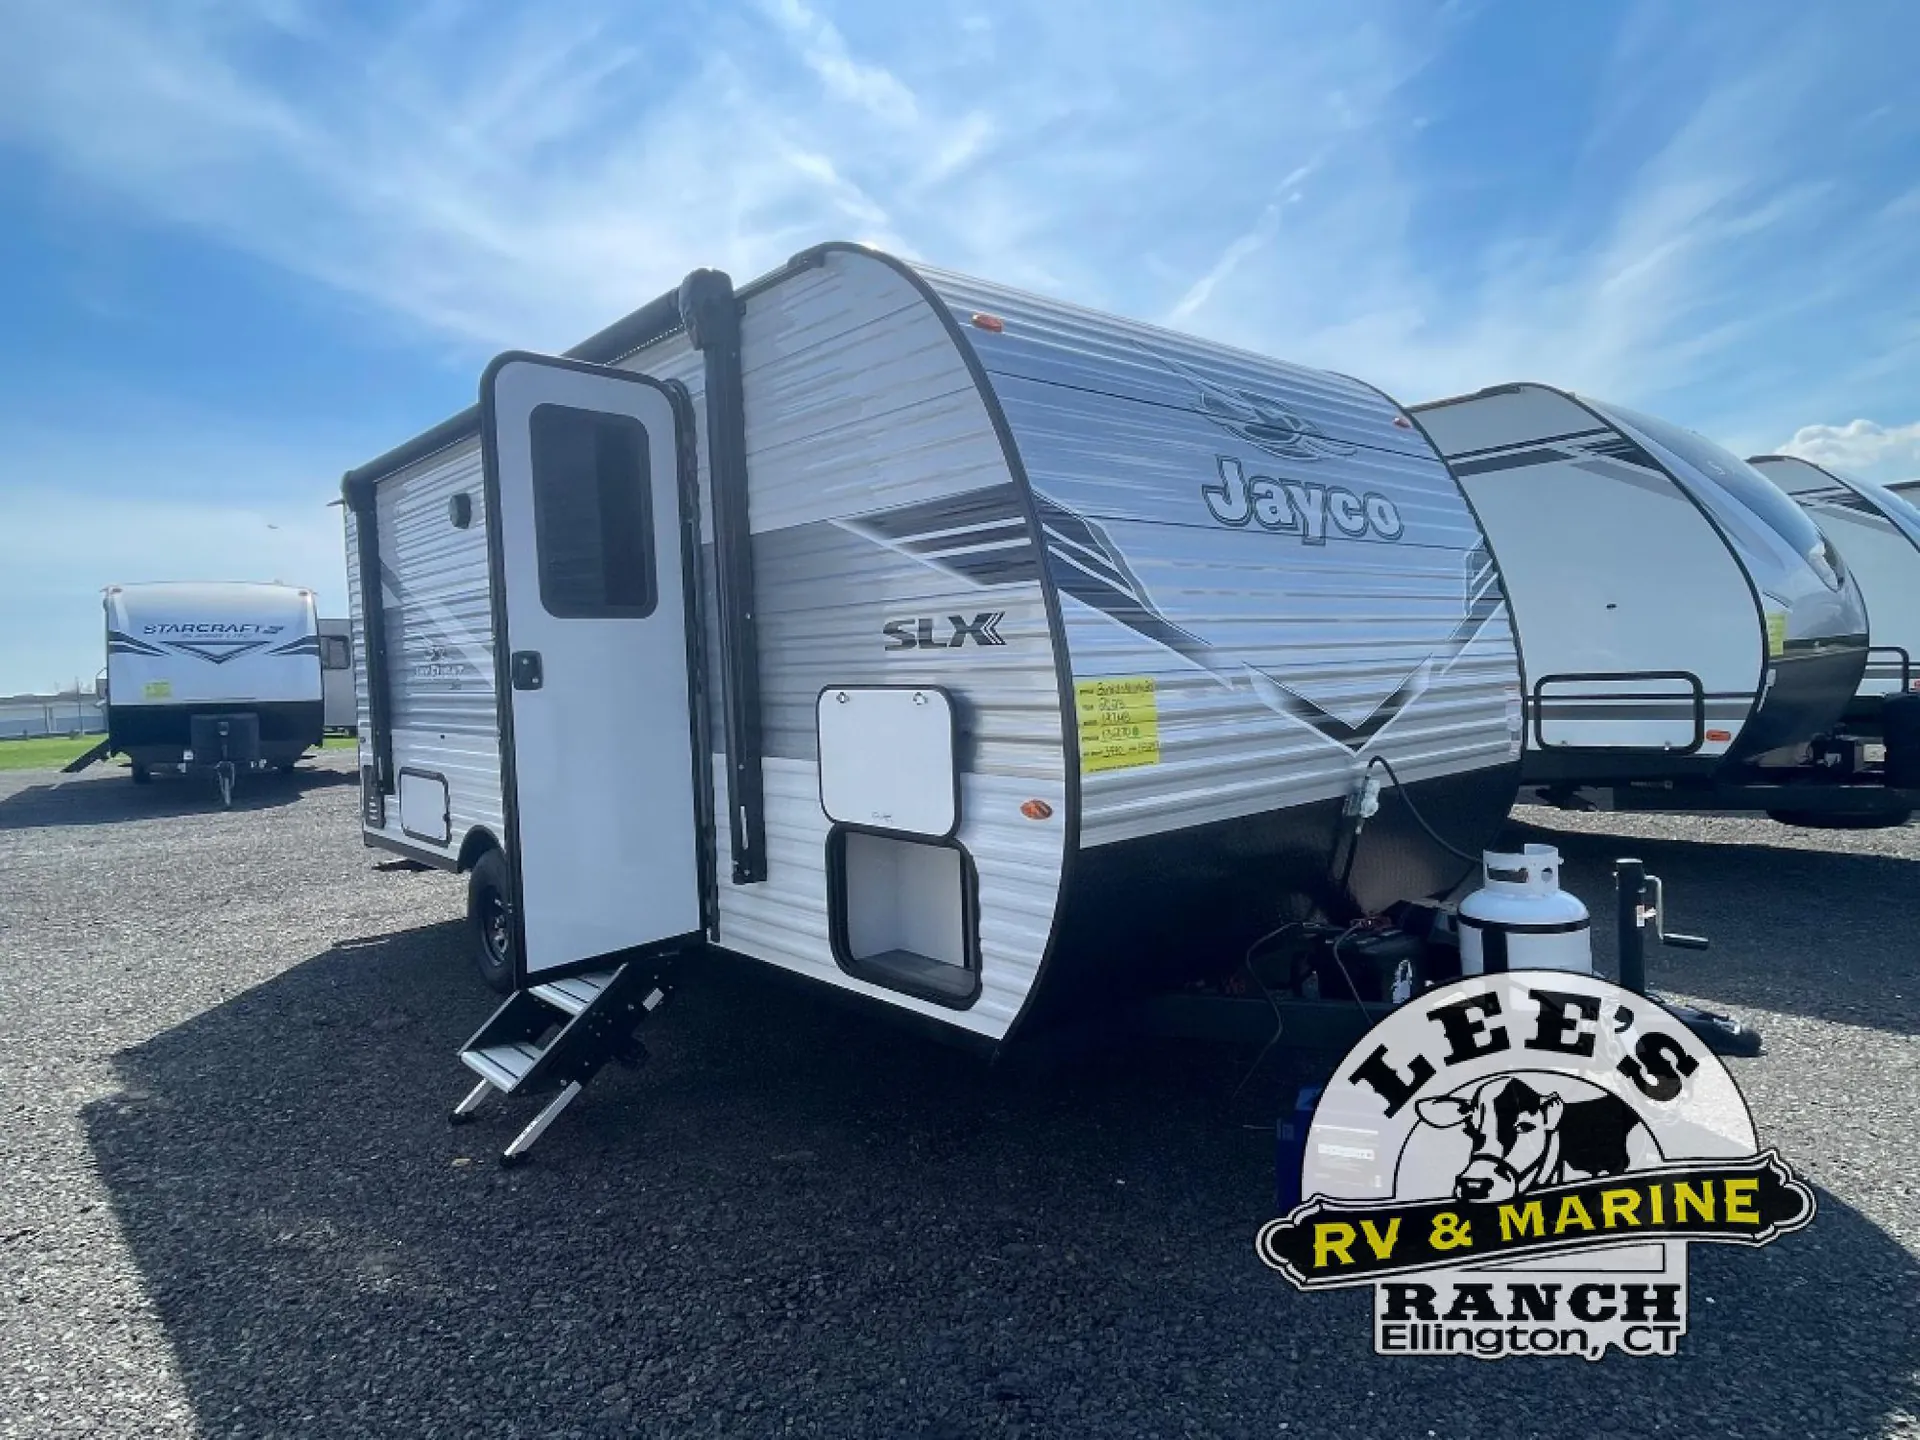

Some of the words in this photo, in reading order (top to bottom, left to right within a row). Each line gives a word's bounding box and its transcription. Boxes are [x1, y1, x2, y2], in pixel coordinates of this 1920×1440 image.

[1202, 454, 1404, 546] Jayco
[143, 623, 262, 635] STARCRAFT
[883, 611, 1007, 651] SLX
